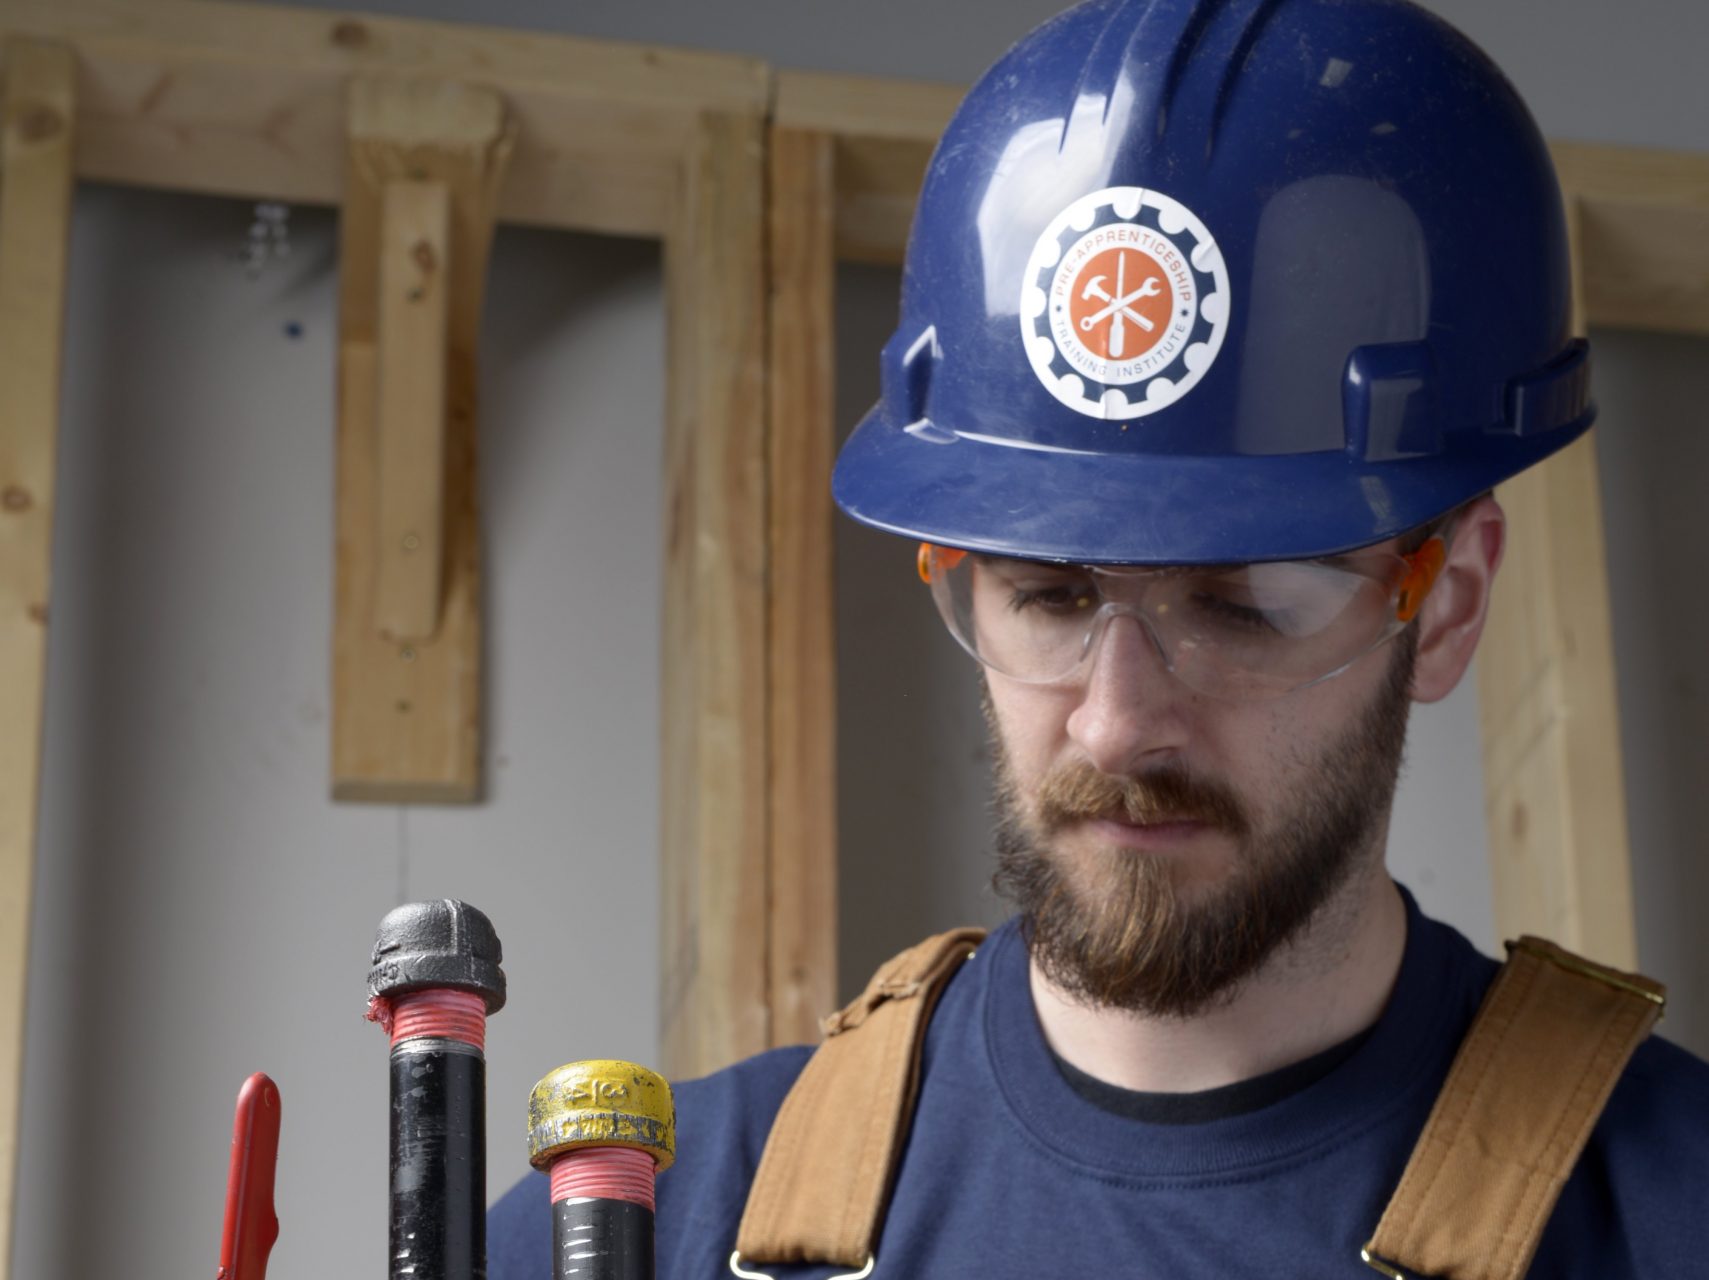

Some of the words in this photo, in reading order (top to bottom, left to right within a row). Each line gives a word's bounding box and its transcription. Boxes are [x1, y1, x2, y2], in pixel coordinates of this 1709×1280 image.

[1055, 229, 1192, 302] PRE-APPRENTICESHIP
[1057, 320, 1107, 376] TRAINING
[1116, 324, 1187, 378] INSTITUTE
